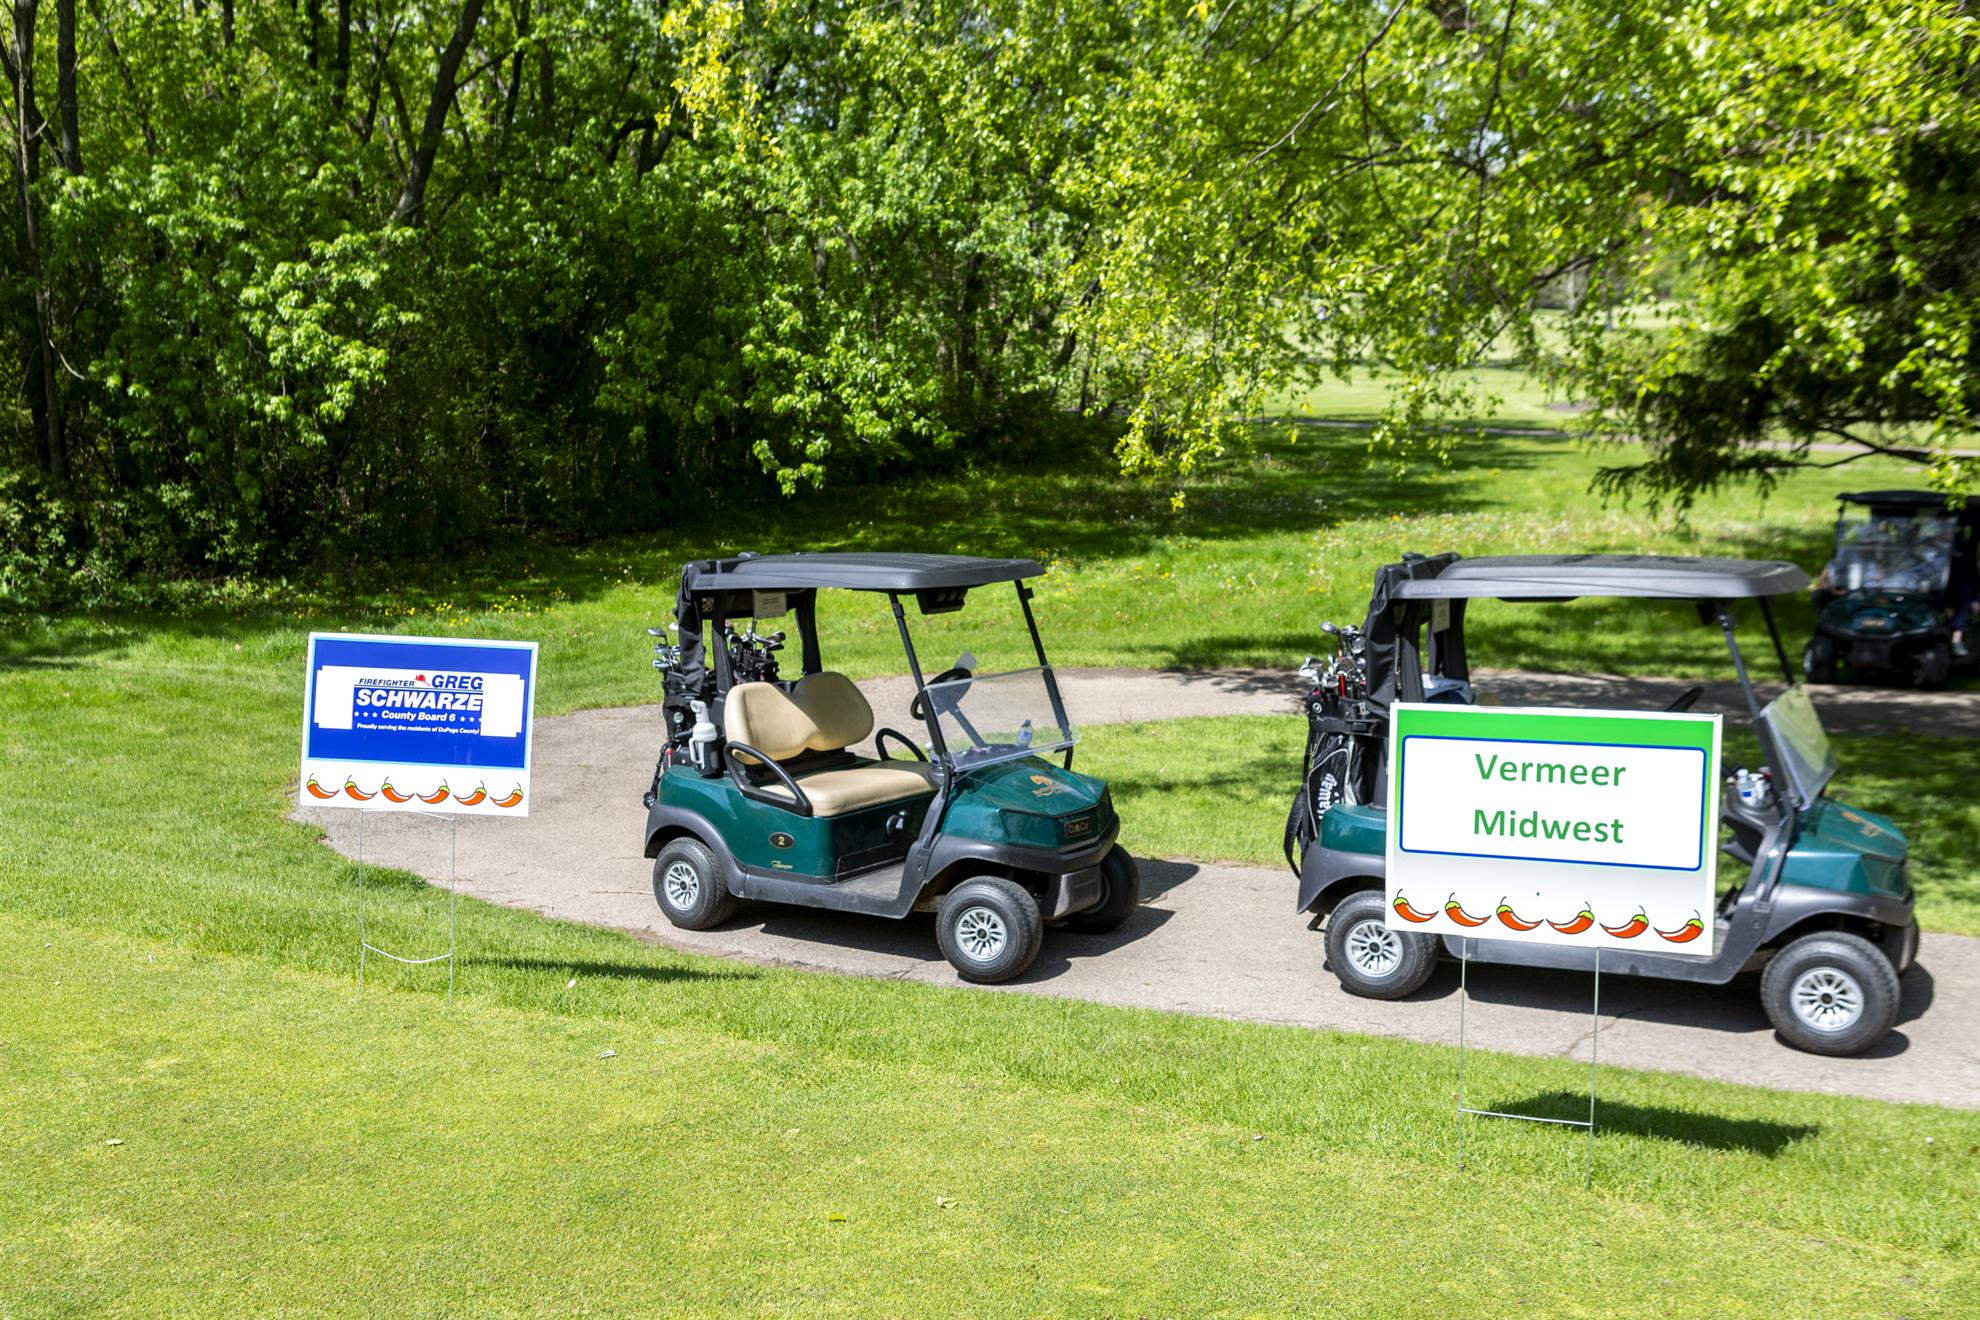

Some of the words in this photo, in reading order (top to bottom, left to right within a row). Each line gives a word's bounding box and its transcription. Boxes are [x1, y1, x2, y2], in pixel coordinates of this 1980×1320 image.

[359, 678, 415, 687] FIREFIGHTER
[431, 674, 484, 690] GREG
[356, 689, 483, 711] SCHWARZE
[381, 710, 416, 721] County
[418, 711, 447, 721] Board
[449, 713, 456, 722] 6
[1474, 753, 1627, 787] Vermeer
[1473, 809, 1625, 844] Midwest
[778, 836, 785, 846] 2
